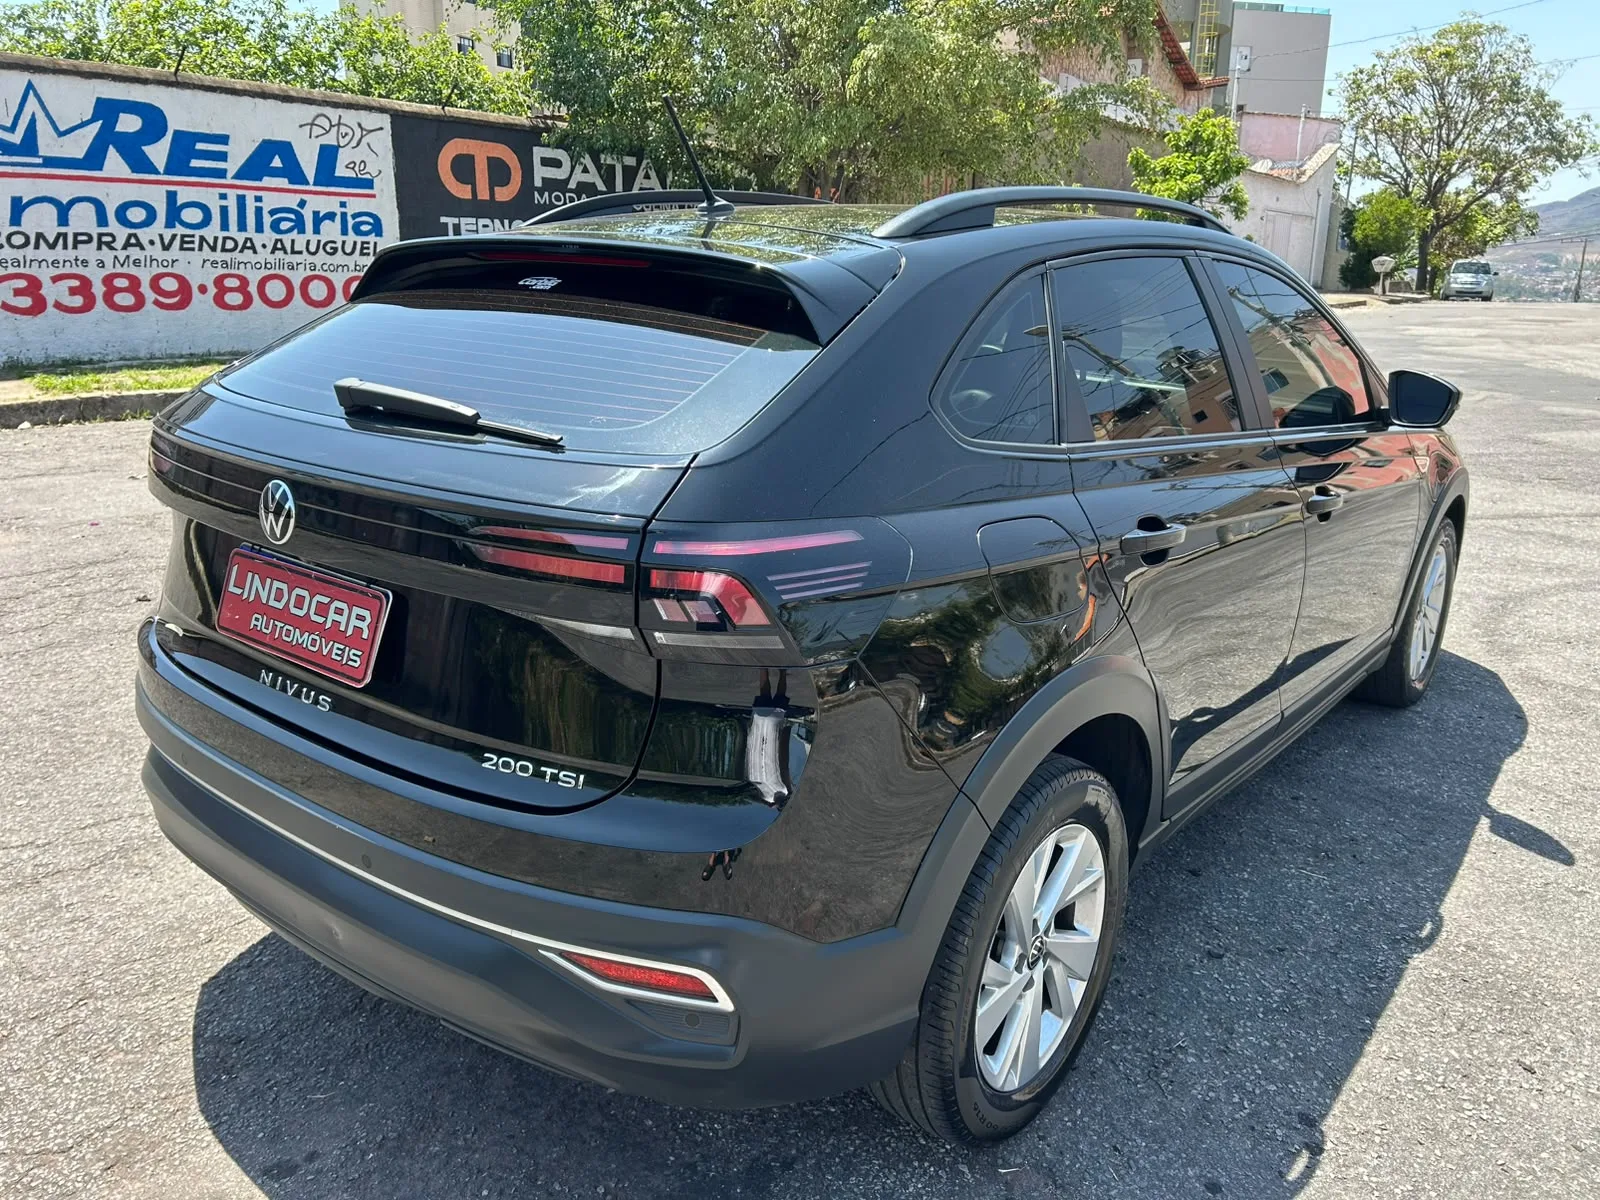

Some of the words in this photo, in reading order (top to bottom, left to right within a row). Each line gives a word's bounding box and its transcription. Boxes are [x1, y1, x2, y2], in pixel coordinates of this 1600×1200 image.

[83, 96, 375, 190] REAL
[532, 146, 673, 193] PATA
[0, 230, 146, 251] OMPRA
[112, 254, 179, 269] Melhor
[227, 563, 373, 641] LINDOCAR
[250, 612, 364, 669] AUTOMÓVEIS
[258, 669, 333, 713] NIVUS
[481, 753, 534, 778] 200
[539, 765, 585, 790] TSI
